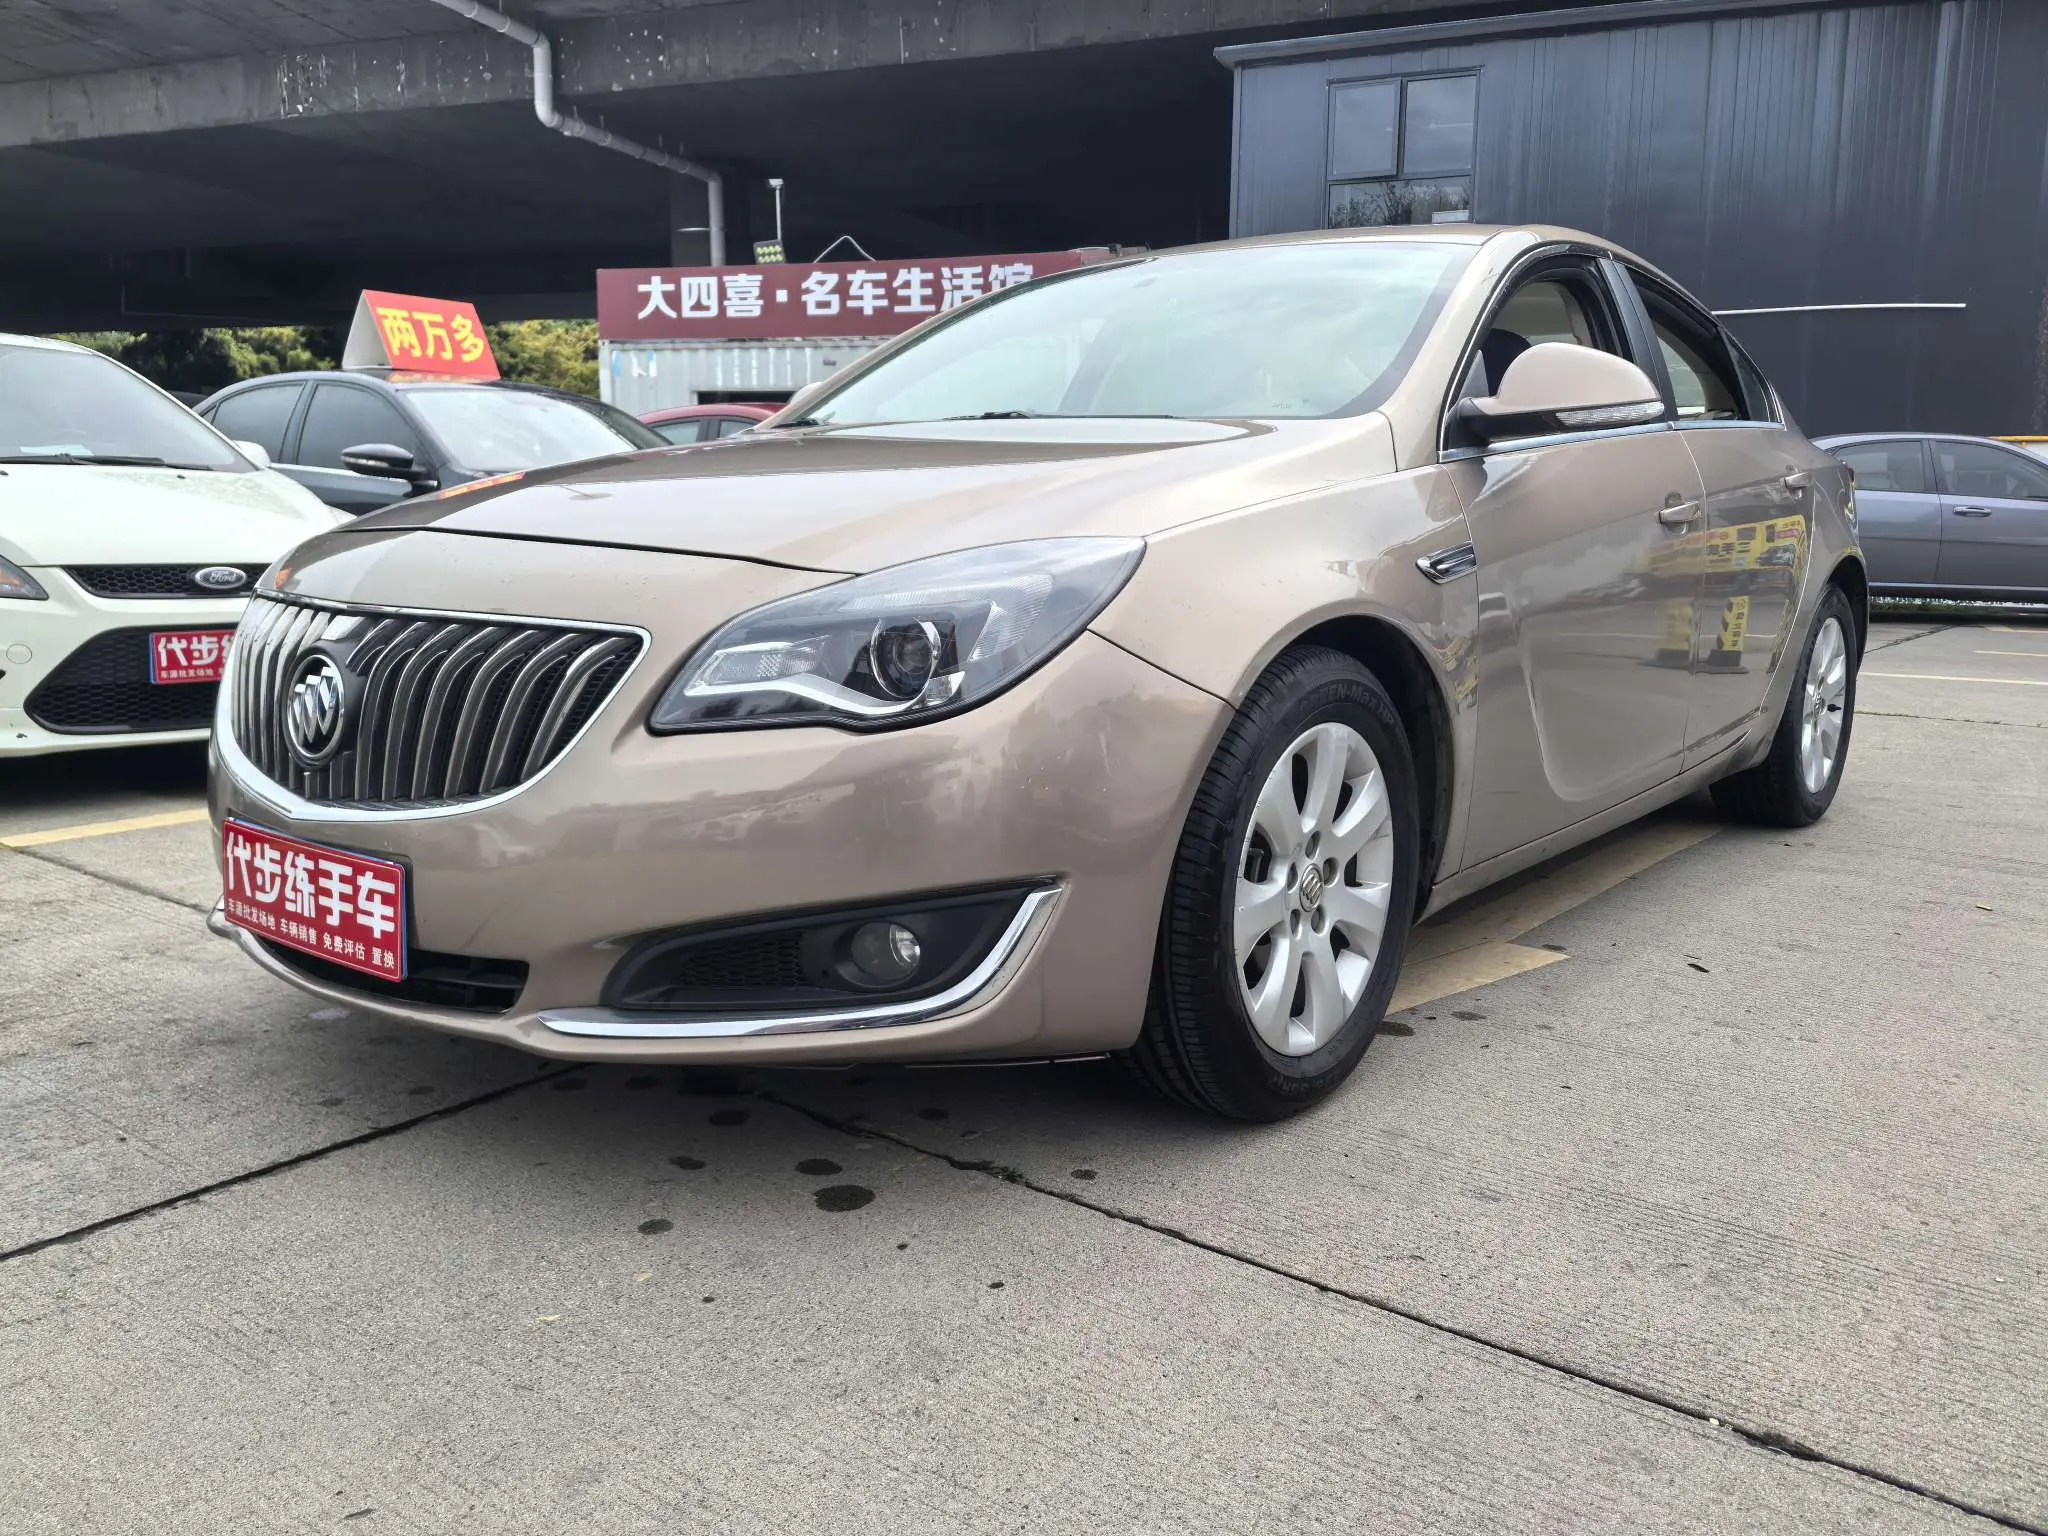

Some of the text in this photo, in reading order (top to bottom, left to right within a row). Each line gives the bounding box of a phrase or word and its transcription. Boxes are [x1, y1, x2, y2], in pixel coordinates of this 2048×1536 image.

[376, 306, 484, 362] 两万多
[209, 570, 237, 583] Ford
[226, 832, 396, 939] 代步练手车
[280, 918, 317, 945] 车辆销售
[323, 932, 365, 961] 免费评估
[372, 946, 395, 969] 置换
